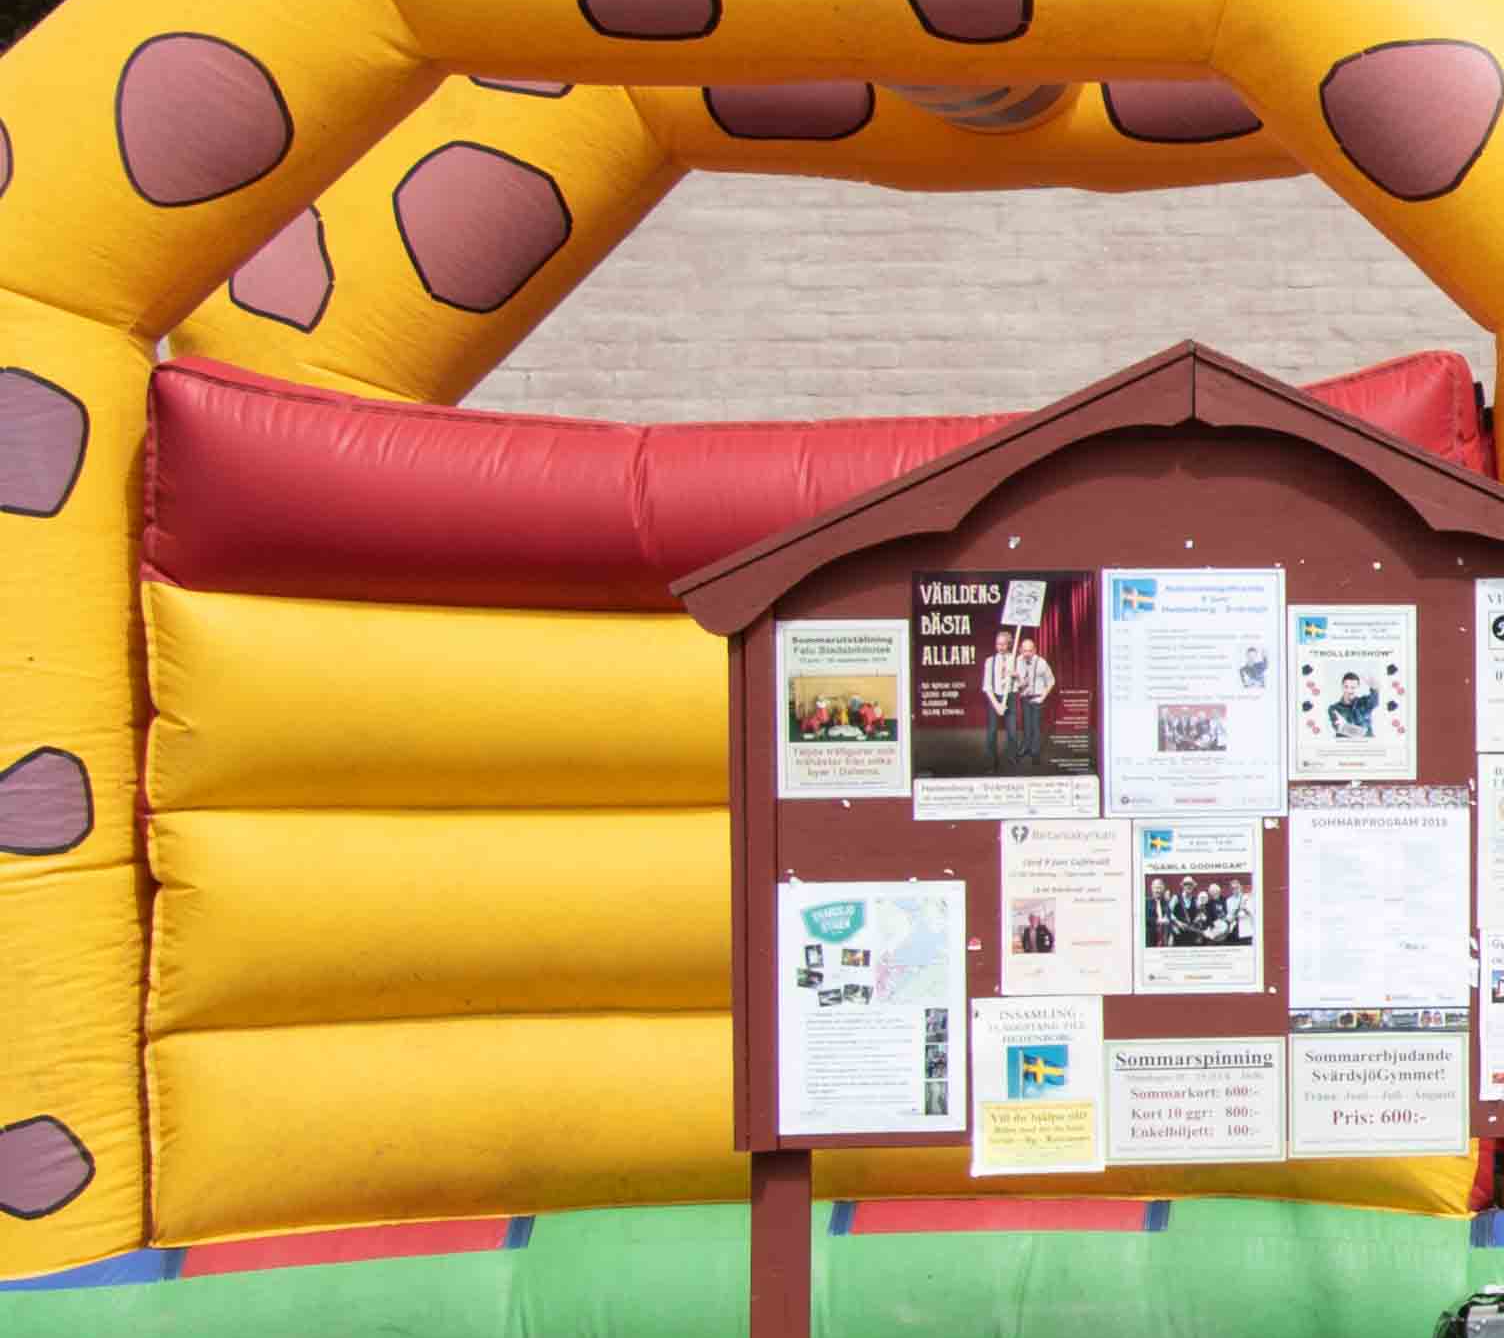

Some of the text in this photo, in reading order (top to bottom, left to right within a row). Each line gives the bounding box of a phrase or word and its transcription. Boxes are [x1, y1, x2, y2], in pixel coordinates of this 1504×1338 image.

[920, 581, 1001, 605] VÄRLDENS
[921, 612, 971, 636] BÄSTA
[922, 645, 976, 666] ALLAN!
[1311, 817, 1419, 828] SOMMARPROGRAM
[1115, 1050, 1273, 1069] Sommarspinning
[1304, 1048, 1454, 1065] Sommarerbjudande
[1311, 1067, 1446, 1085] SvärdsjöGymmet!
[1130, 1085, 1260, 1100] Sommarkort: 600:-
[1131, 1106, 1261, 1122] Kort 10 ggr: 800:-
[1332, 1109, 1427, 1126] Pris: 600:-
[1131, 1124, 1261, 1140] Enkelbiljett: 100:-
